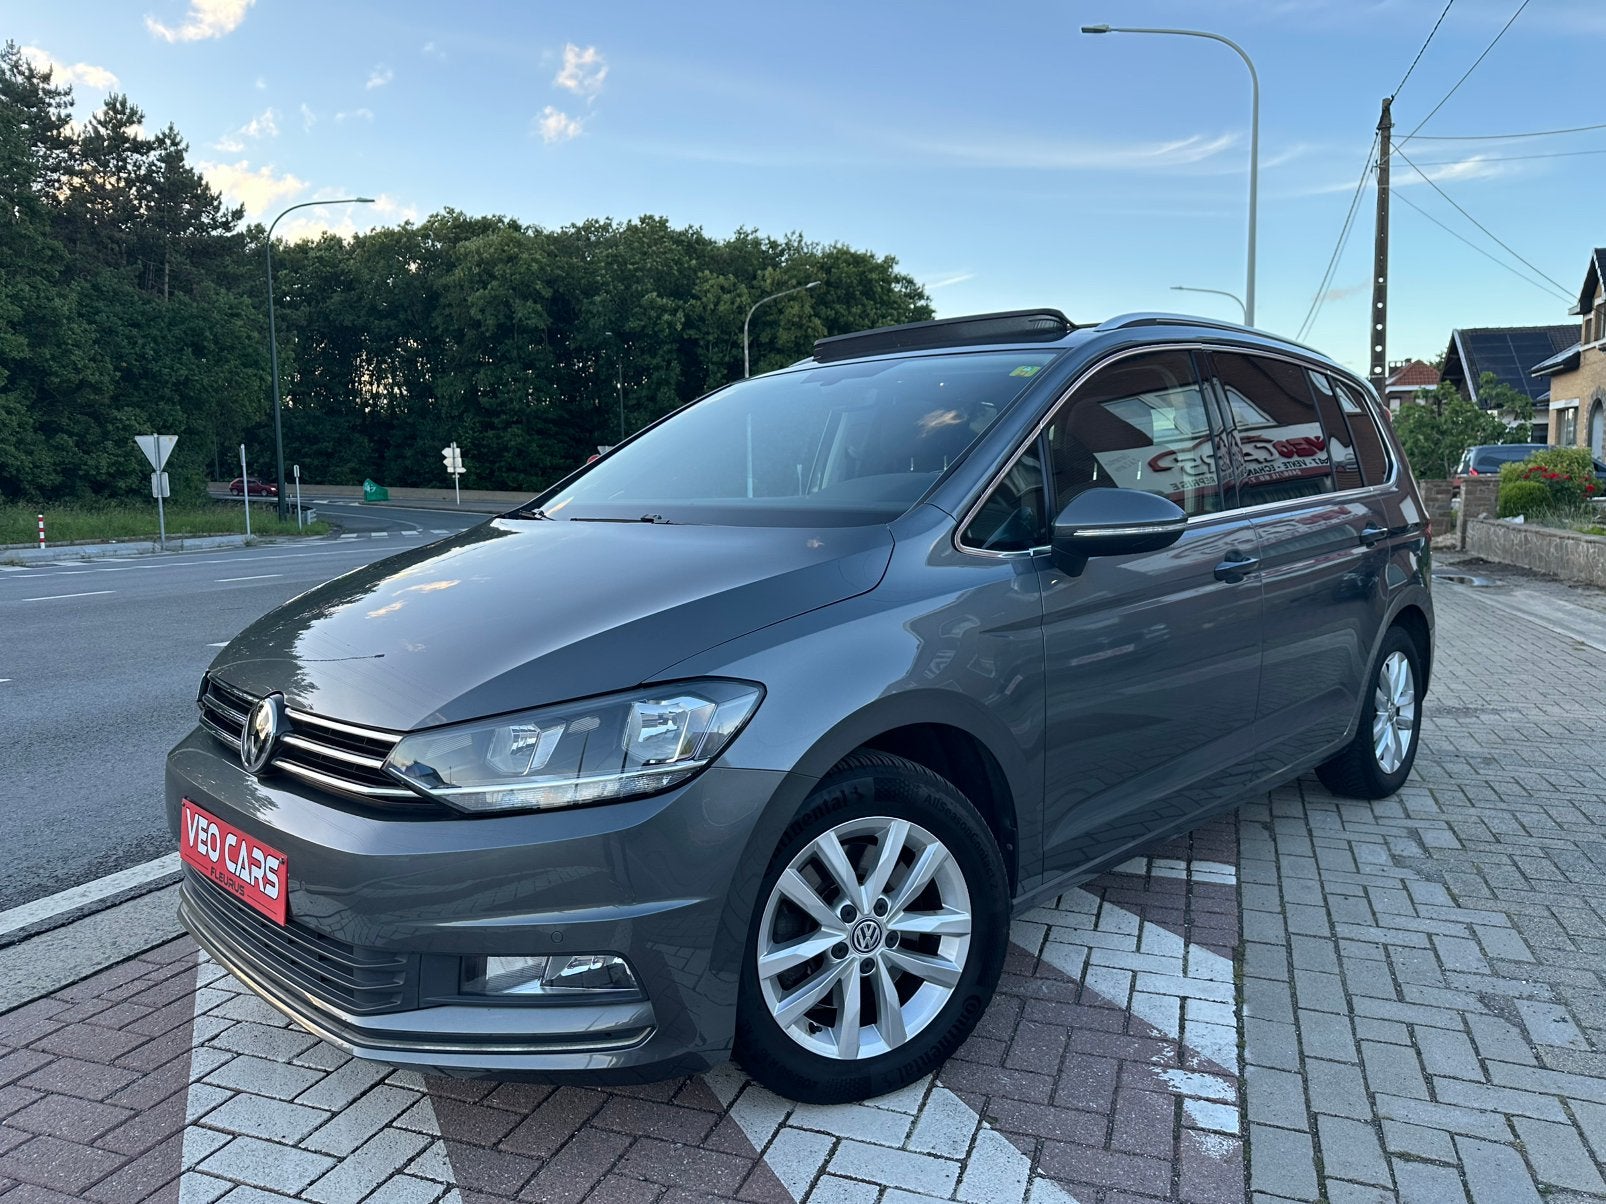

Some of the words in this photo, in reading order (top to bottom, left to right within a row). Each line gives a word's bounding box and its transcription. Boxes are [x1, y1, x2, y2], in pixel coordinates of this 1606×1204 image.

[186, 807, 221, 863] VEO
[224, 831, 280, 900] CARS
[210, 865, 246, 897] FLEURUS
